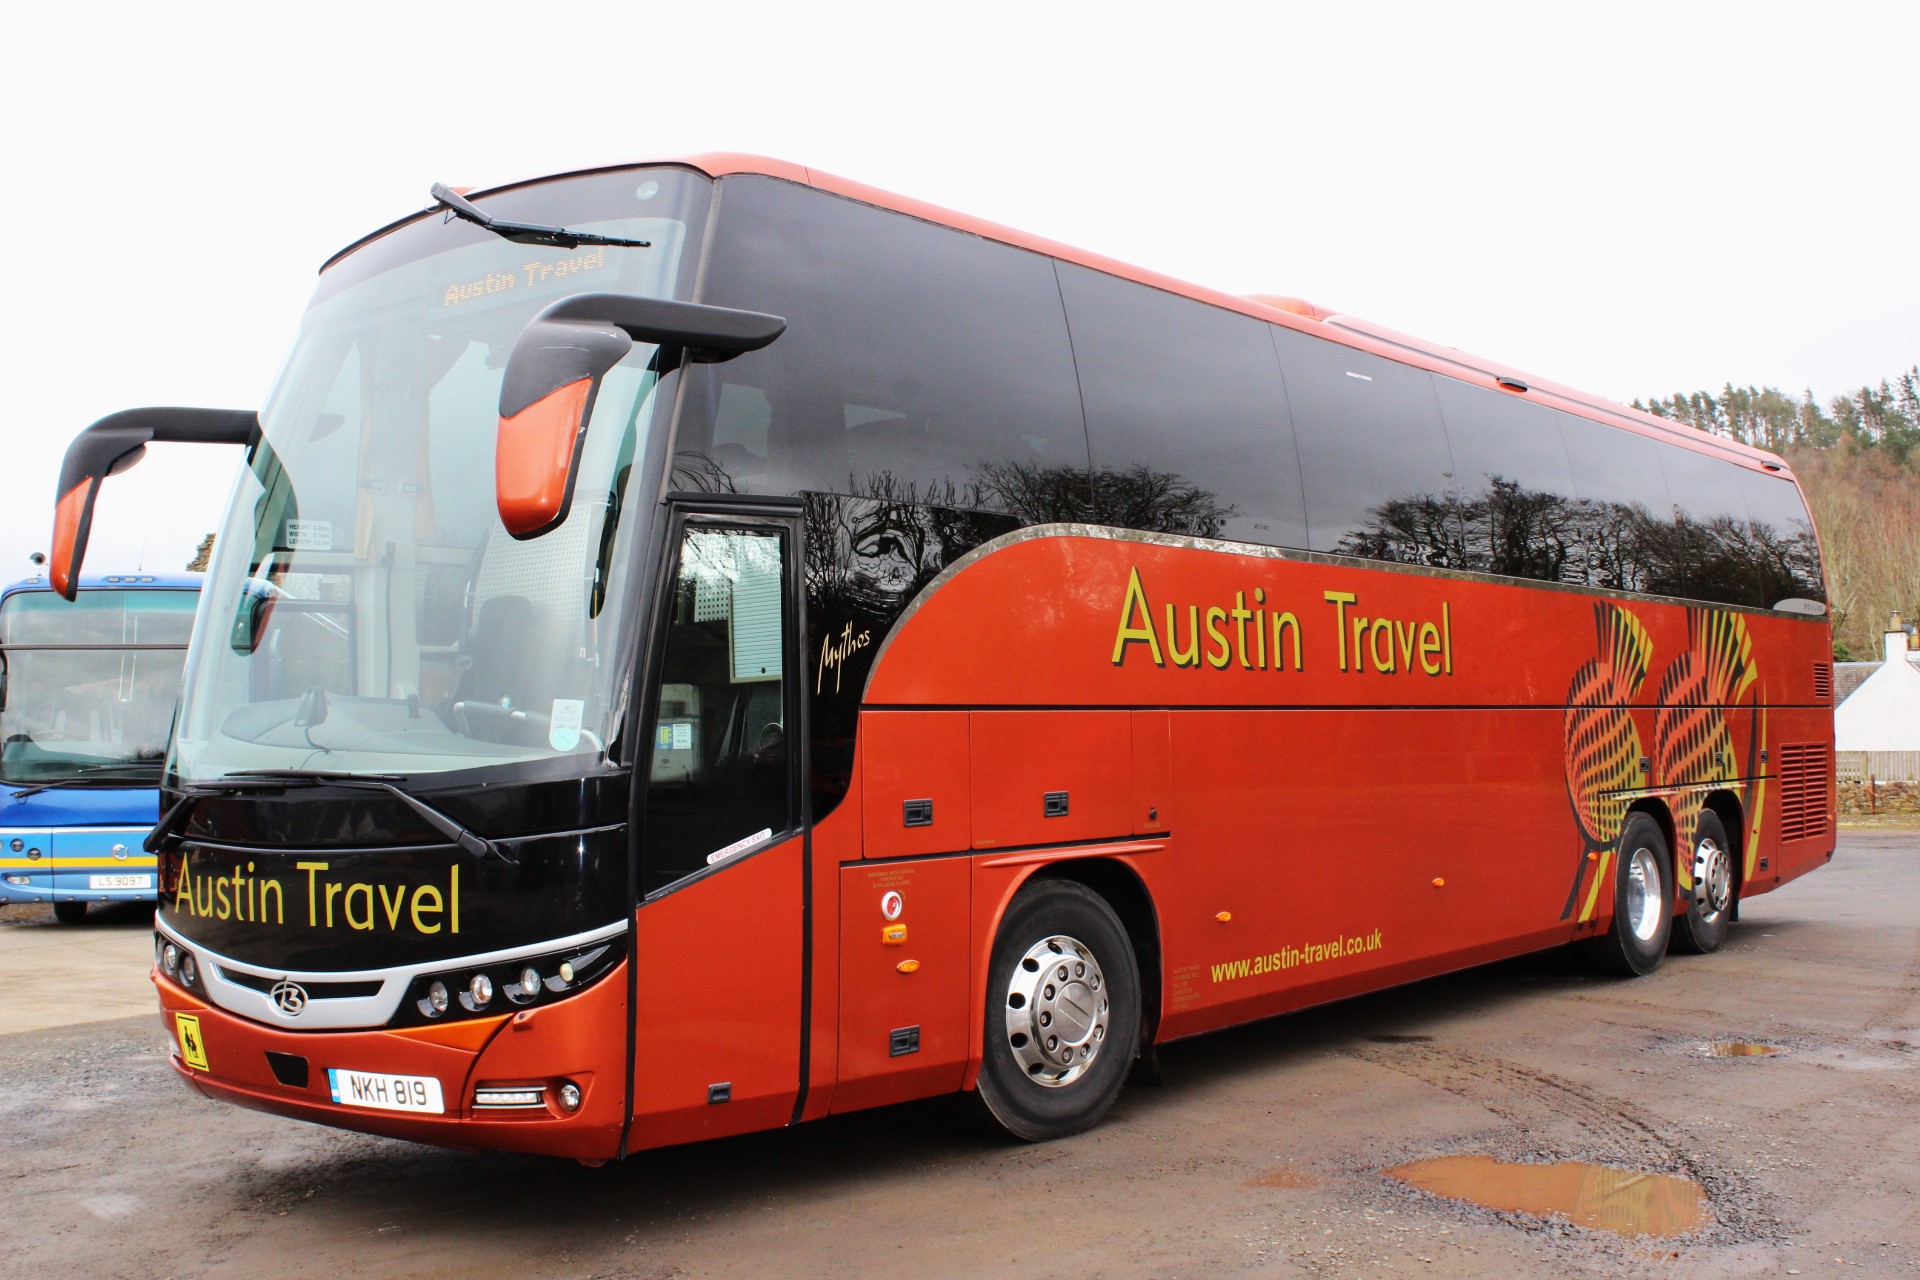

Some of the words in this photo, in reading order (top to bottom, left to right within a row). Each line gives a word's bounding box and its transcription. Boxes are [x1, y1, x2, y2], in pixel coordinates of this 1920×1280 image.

[444, 273, 516, 306] Austin
[523, 246, 607, 287] Travel
[1111, 565, 1302, 672] Austin
[1323, 590, 1453, 675] Travel
[816, 620, 870, 695] Mythos
[710, 840, 750, 862] EMERGENCY
[752, 831, 766, 843] EXIT
[99, 876, 112, 886] LS
[116, 876, 143, 886] 9097
[174, 851, 284, 925] Austin
[296, 861, 459, 934] Travel
[1211, 928, 1382, 983] www.austin-travel.co.uk
[350, 1075, 389, 1103] NKH
[393, 1079, 428, 1106] 819
